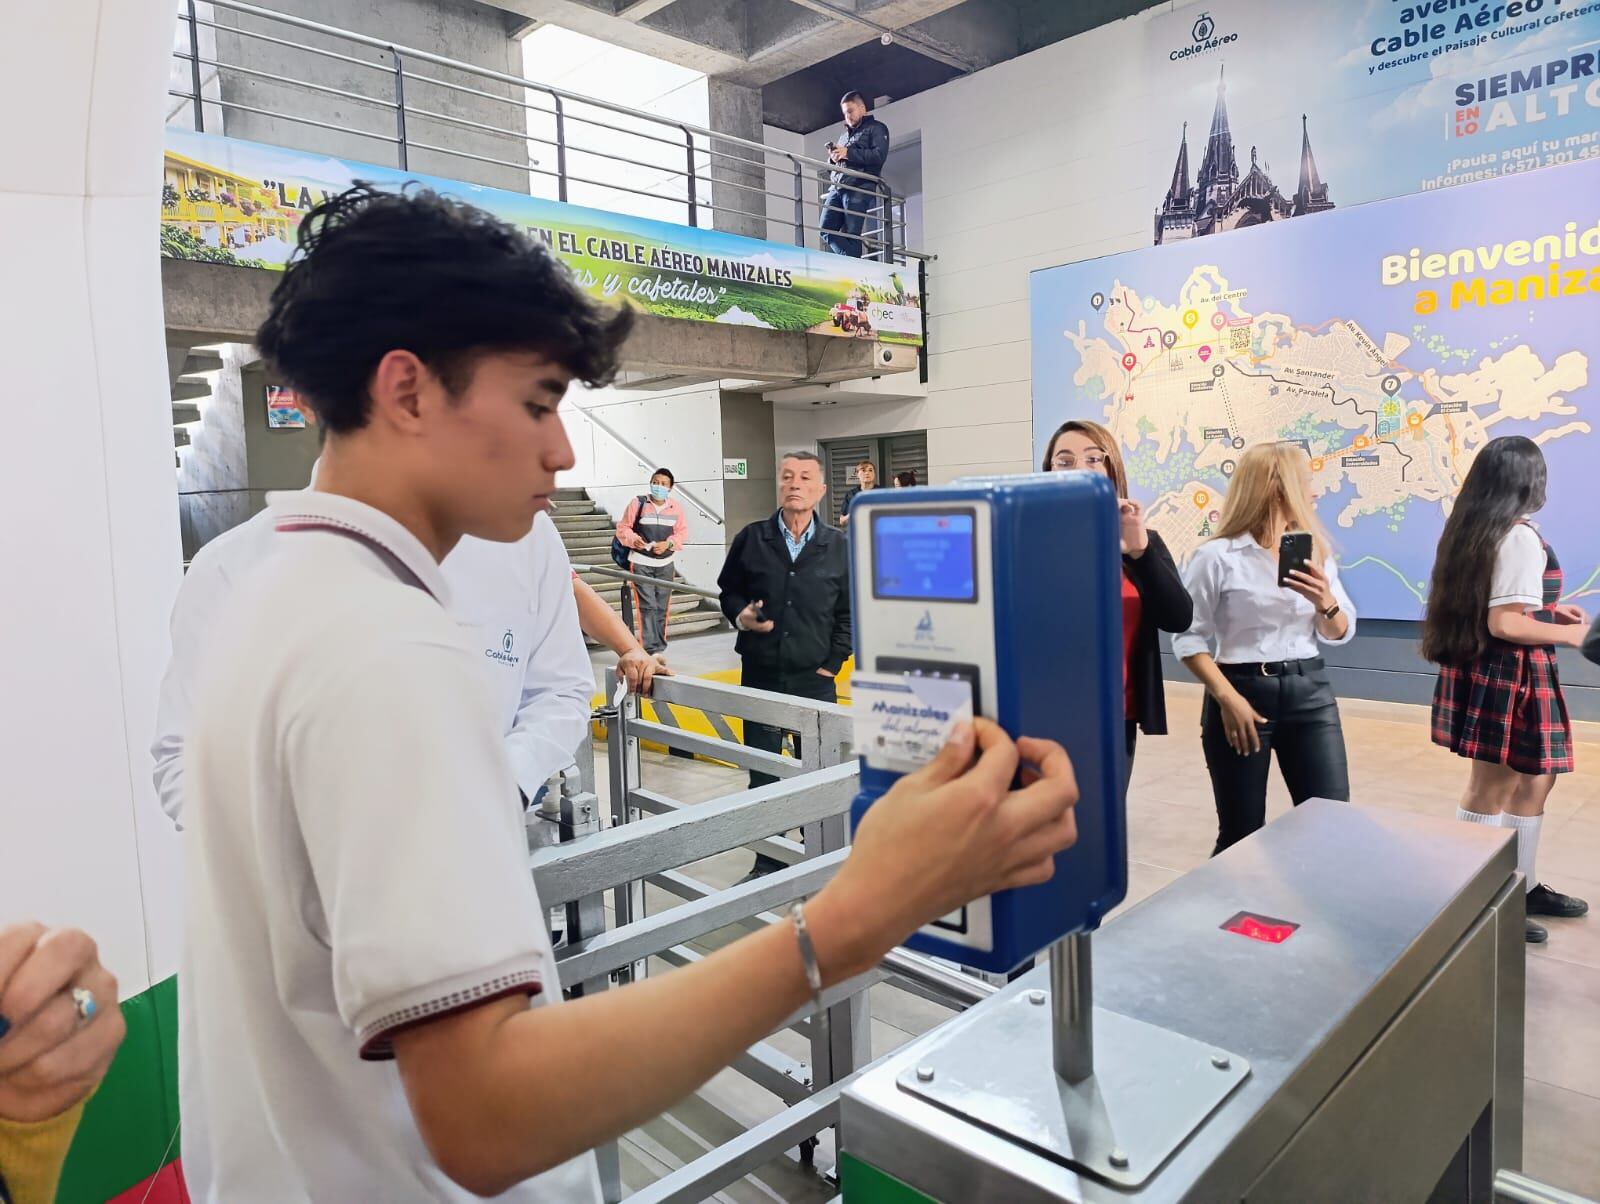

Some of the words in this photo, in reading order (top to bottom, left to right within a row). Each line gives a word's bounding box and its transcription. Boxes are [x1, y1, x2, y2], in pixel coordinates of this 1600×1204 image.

[1400, 0, 1479, 24] aven
[1371, 24, 1446, 56] Cable
[1454, 0, 1543, 34] Aéreo
[1169, 44, 1202, 61] Cable
[1203, 33, 1238, 51] Aéreo
[1368, 64, 1376, 76] y
[1377, 50, 1429, 71] descubre
[1432, 46, 1443, 57] el
[1445, 34, 1488, 54] Paisaje
[1491, 19, 1540, 40] Cultural
[1455, 48, 1600, 106] SIEMPR
[1455, 105, 1480, 122] EN
[1455, 121, 1479, 138] LO
[1502, 140, 1538, 160] aquí
[1542, 139, 1560, 152] tu
[1421, 167, 1498, 191] Informes:
[1545, 150, 1574, 167] 301
[558, 231, 583, 255] EL
[586, 237, 646, 265] CABLE
[650, 245, 704, 274] AÉREO
[706, 257, 793, 287] MANIZALES
[601, 272, 623, 297] y
[1413, 290, 1438, 315] a
[1354, 331, 1371, 350] Kevin
[1284, 366, 1294, 375] Av.
[1296, 368, 1335, 380] Santander
[1387, 381, 1394, 389] 7
[1298, 387, 1329, 399] Paralela
